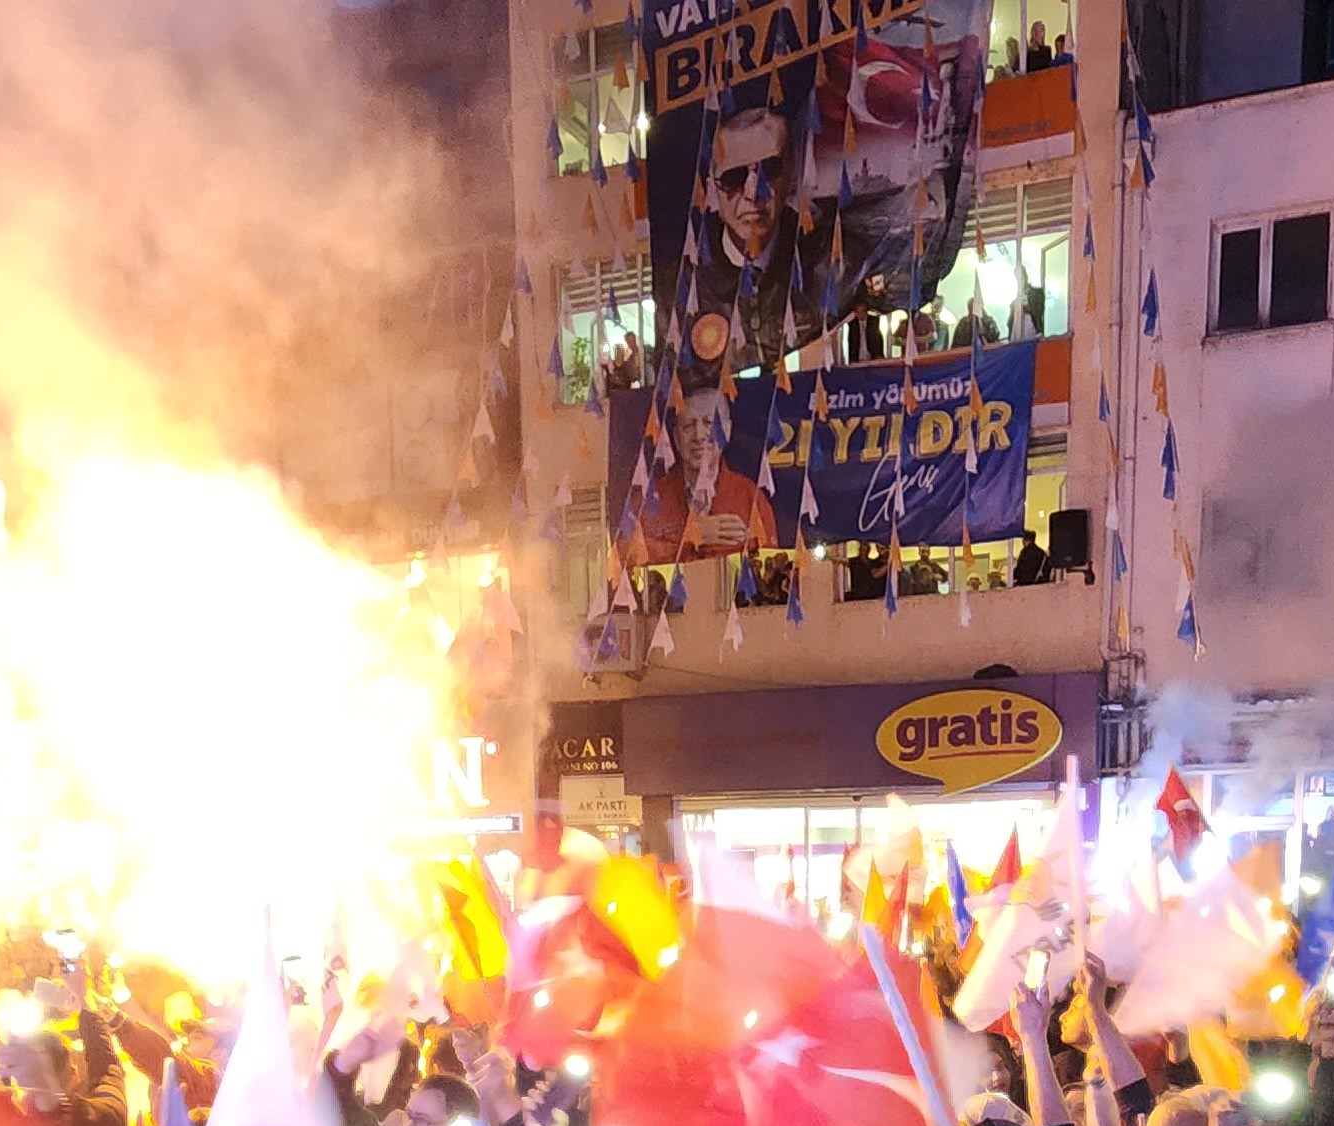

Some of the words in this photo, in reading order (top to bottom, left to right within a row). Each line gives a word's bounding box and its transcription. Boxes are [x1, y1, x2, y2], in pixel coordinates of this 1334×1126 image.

[827, 400, 1013, 464] YILDIR
[896, 699, 1041, 762] gratis
[579, 801, 593, 811] AK
